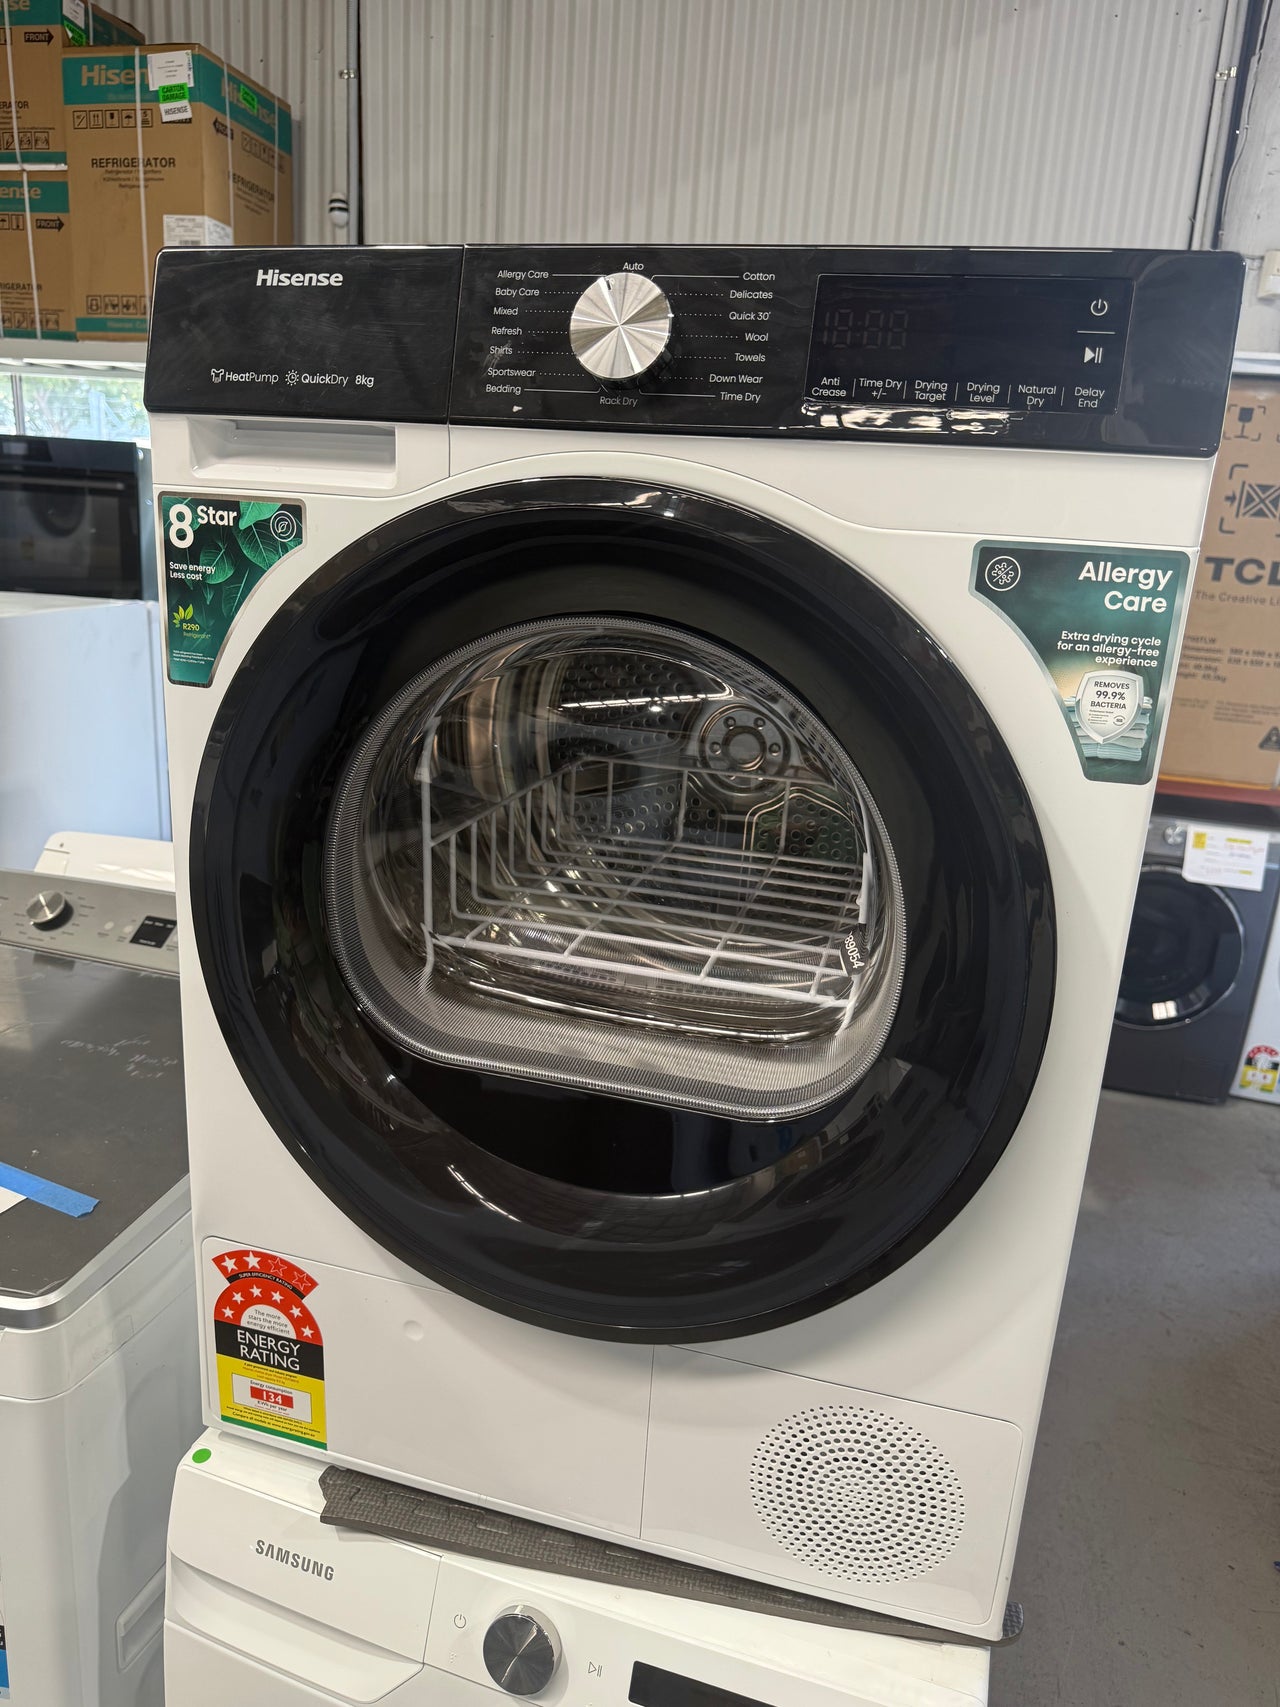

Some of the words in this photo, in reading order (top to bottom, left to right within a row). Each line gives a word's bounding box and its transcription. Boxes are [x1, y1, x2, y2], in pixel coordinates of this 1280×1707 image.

[25, 33, 49, 41] FRONT
[622, 261, 644, 271] Auto
[256, 268, 344, 287] Hisense
[497, 270, 526, 280] Allergy
[527, 270, 549, 279] Care
[743, 271, 775, 281] Cotton
[495, 287, 517, 298] Baby
[518, 287, 540, 296] Care
[729, 289, 773, 299] Delicates
[493, 306, 519, 316] Mixed
[728, 311, 756, 321] Quick
[491, 326, 523, 336] Refresh
[744, 332, 769, 342] Wool
[489, 346, 513, 355] Shirts
[734, 352, 766, 362] Towels
[487, 368, 536, 378] Sportswear
[225, 371, 279, 385] HeatPump
[301, 373, 348, 388] QuickDry
[355, 374, 375, 388] 8kg
[709, 374, 737, 384] Down
[738, 374, 763, 384] Wear
[820, 377, 840, 386] Anti
[859, 378, 882, 388] Time
[884, 379, 903, 391] Dry
[485, 384, 522, 395] Bedding
[914, 380, 948, 393] Drying
[966, 382, 1000, 394] Drying
[1018, 384, 1056, 395] Natural
[720, 391, 742, 401] Time
[743, 393, 761, 403] Dry
[811, 387, 847, 398] Crease
[914, 391, 947, 402] Target
[969, 393, 995, 403] Level
[1074, 387, 1105, 399] Delay
[599, 396, 619, 406] Rack
[620, 397, 638, 408] Dry
[1026, 396, 1045, 407] Dry
[1078, 398, 1099, 408] End
[169, 503, 194, 548] 8
[196, 505, 237, 527] Star
[169, 561, 187, 571] Save
[189, 563, 216, 575] energy
[169, 570, 185, 580] Less
[186, 572, 203, 581] cost
[1078, 560, 1173, 592] Allergy
[1104, 590, 1167, 613] Care
[1195, 590, 1215, 600] The
[1218, 592, 1266, 605] Creative
[182, 622, 200, 631] R290
[1061, 630, 1090, 641] Extra
[1091, 632, 1129, 647] drying
[1131, 636, 1161, 648] cycle
[1057, 641, 1073, 650] for
[1074, 643, 1090, 652] an
[1092, 643, 1160, 658] allergy-free
[1095, 654, 1158, 668] experience
[1094, 681, 1130, 690] REMOVES
[1096, 690, 1126, 700] 99.9%
[1090, 700, 1127, 709] BACTERIA
[266, 1312, 280, 1320] more
[246, 1320, 267, 1330] energy
[266, 1325, 291, 1336] efficient
[272, 1320, 288, 1329] more
[236, 1329, 300, 1356] ENERGY
[240, 1345, 300, 1371] RATING
[250, 1379, 265, 1389] Energy
[262, 1390, 283, 1405] 134
[255, 1538, 335, 1582] SAMSUNG
